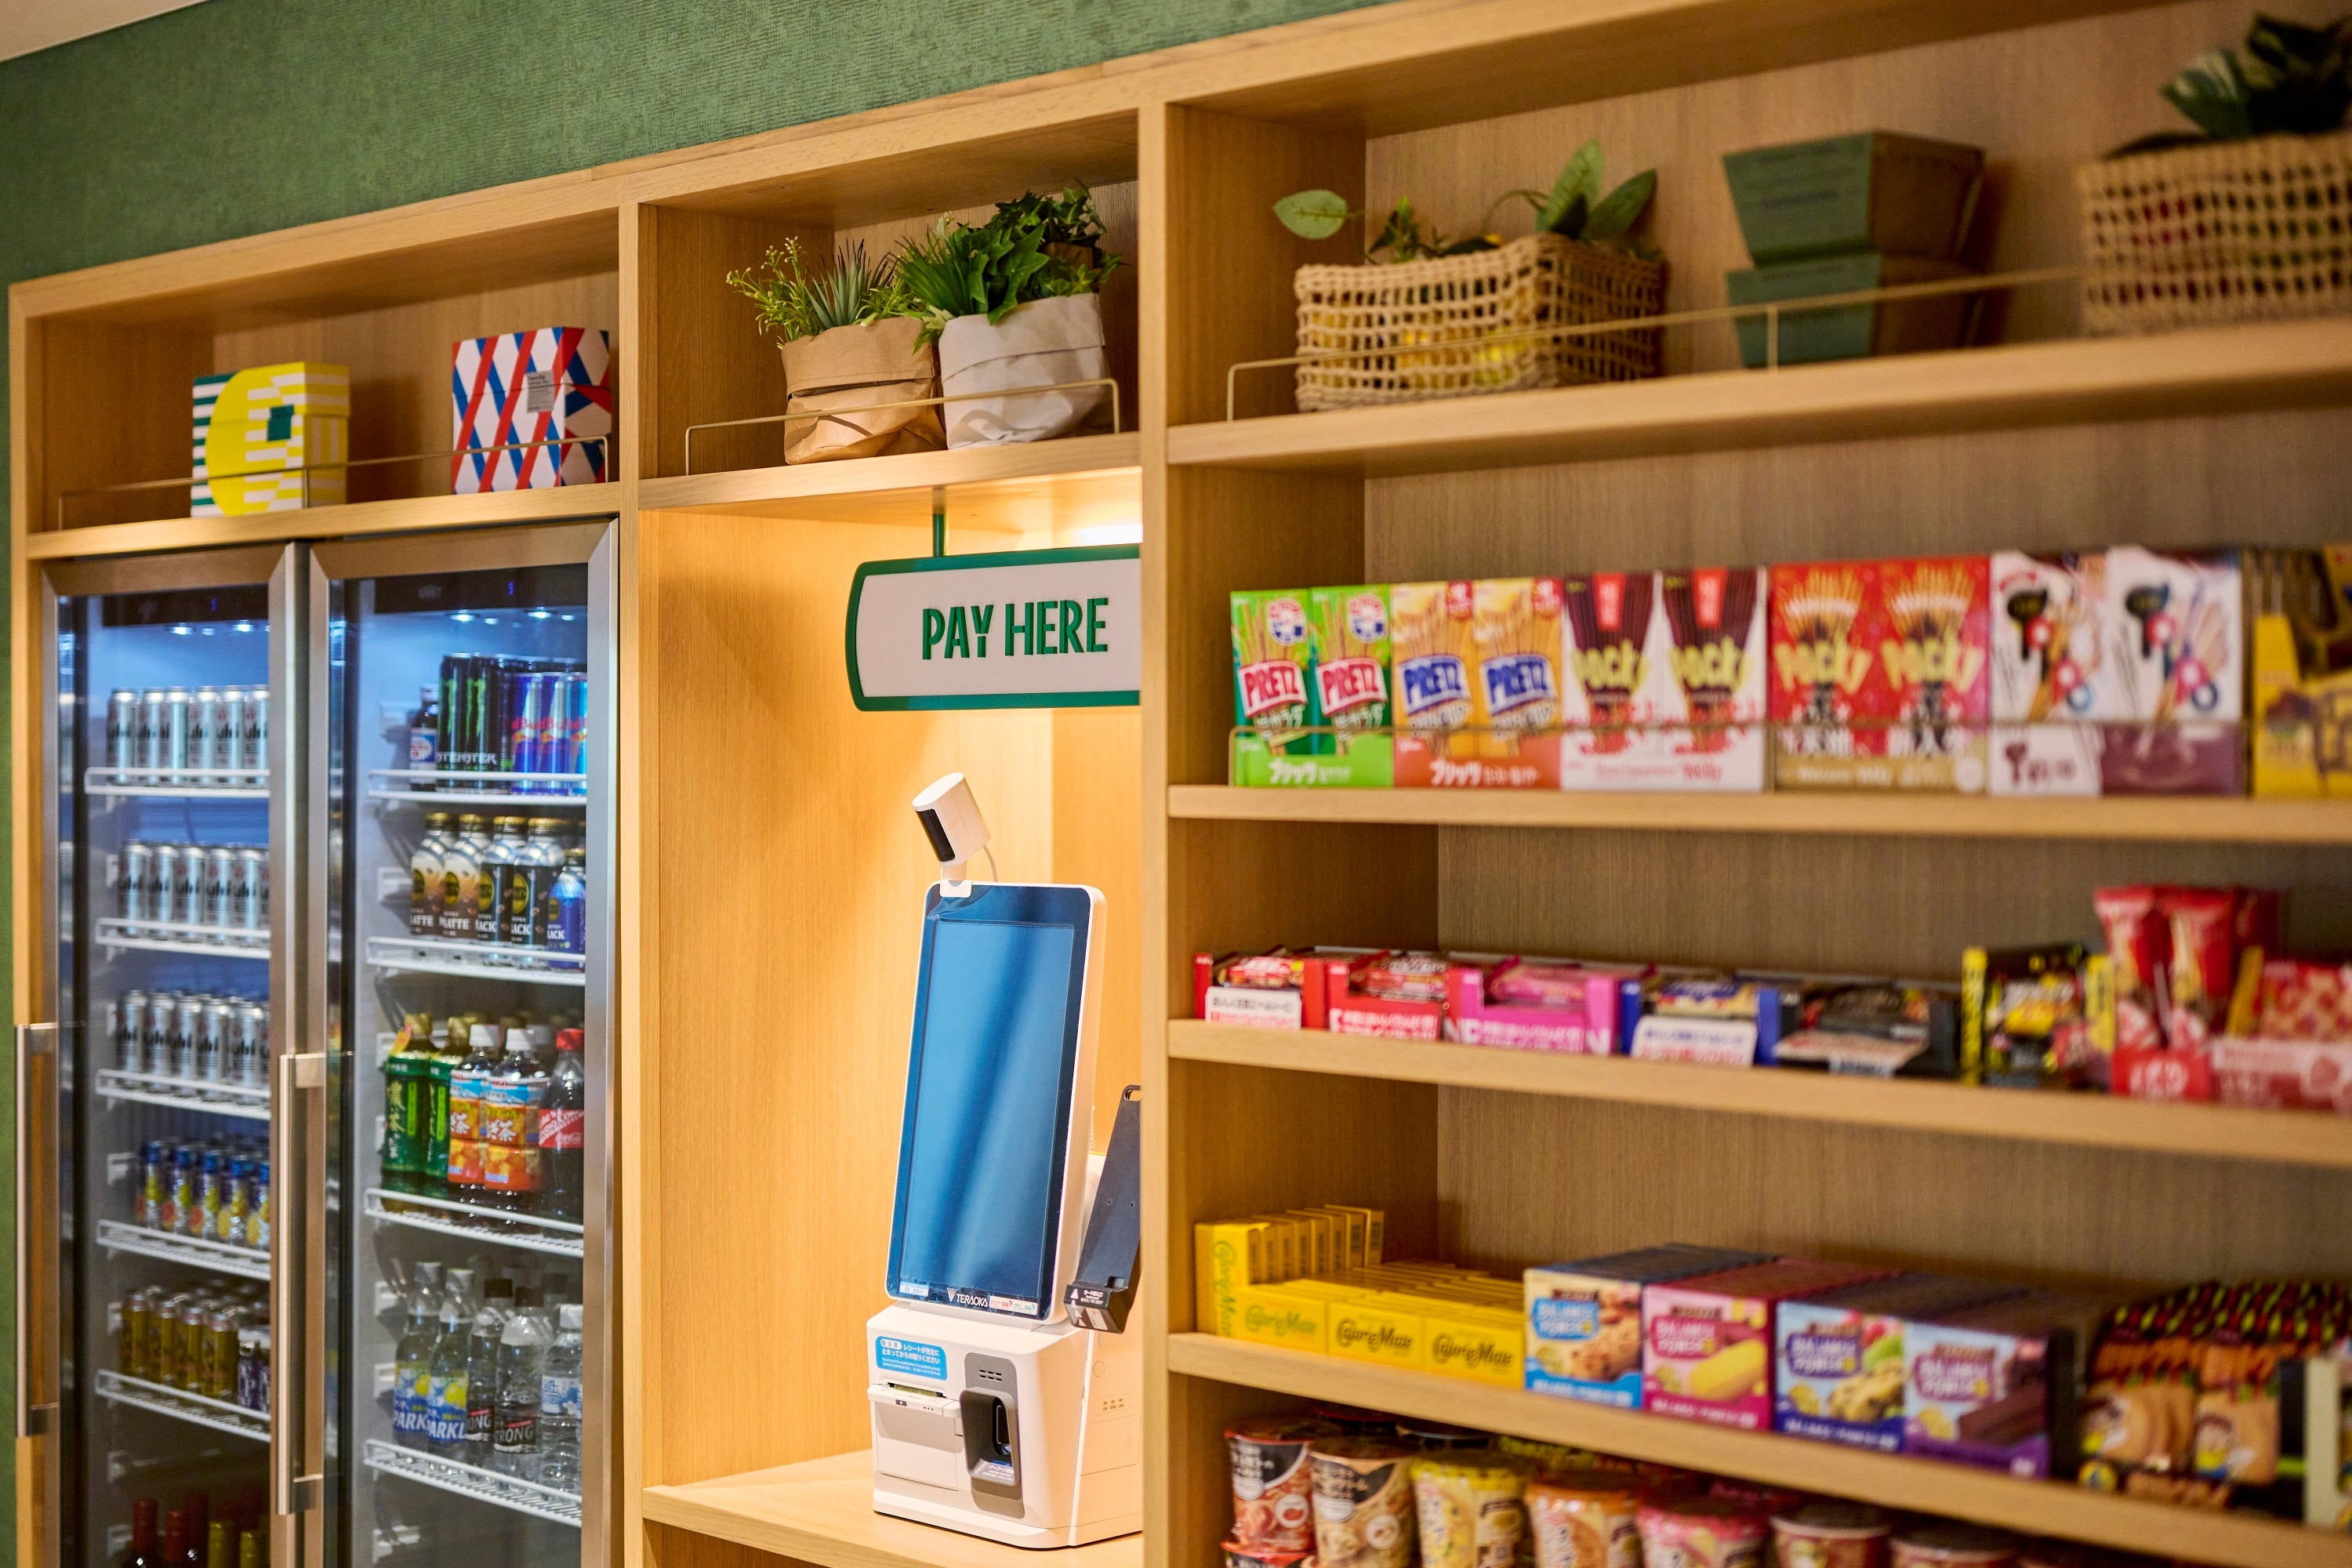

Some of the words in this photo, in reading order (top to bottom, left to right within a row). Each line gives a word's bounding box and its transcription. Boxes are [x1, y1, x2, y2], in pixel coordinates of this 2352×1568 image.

[922, 604, 994, 659] PAY
[1004, 597, 1109, 656] HERE
[1243, 665, 1299, 707] PRETZ
[1323, 663, 1377, 708] PRETZ
[1403, 661, 1461, 706] PRETZ
[1486, 661, 1547, 706] PRETZ
[956, 1293, 988, 1308] TERAOKA
[881, 1348, 940, 1364] 止まってからお取りください
